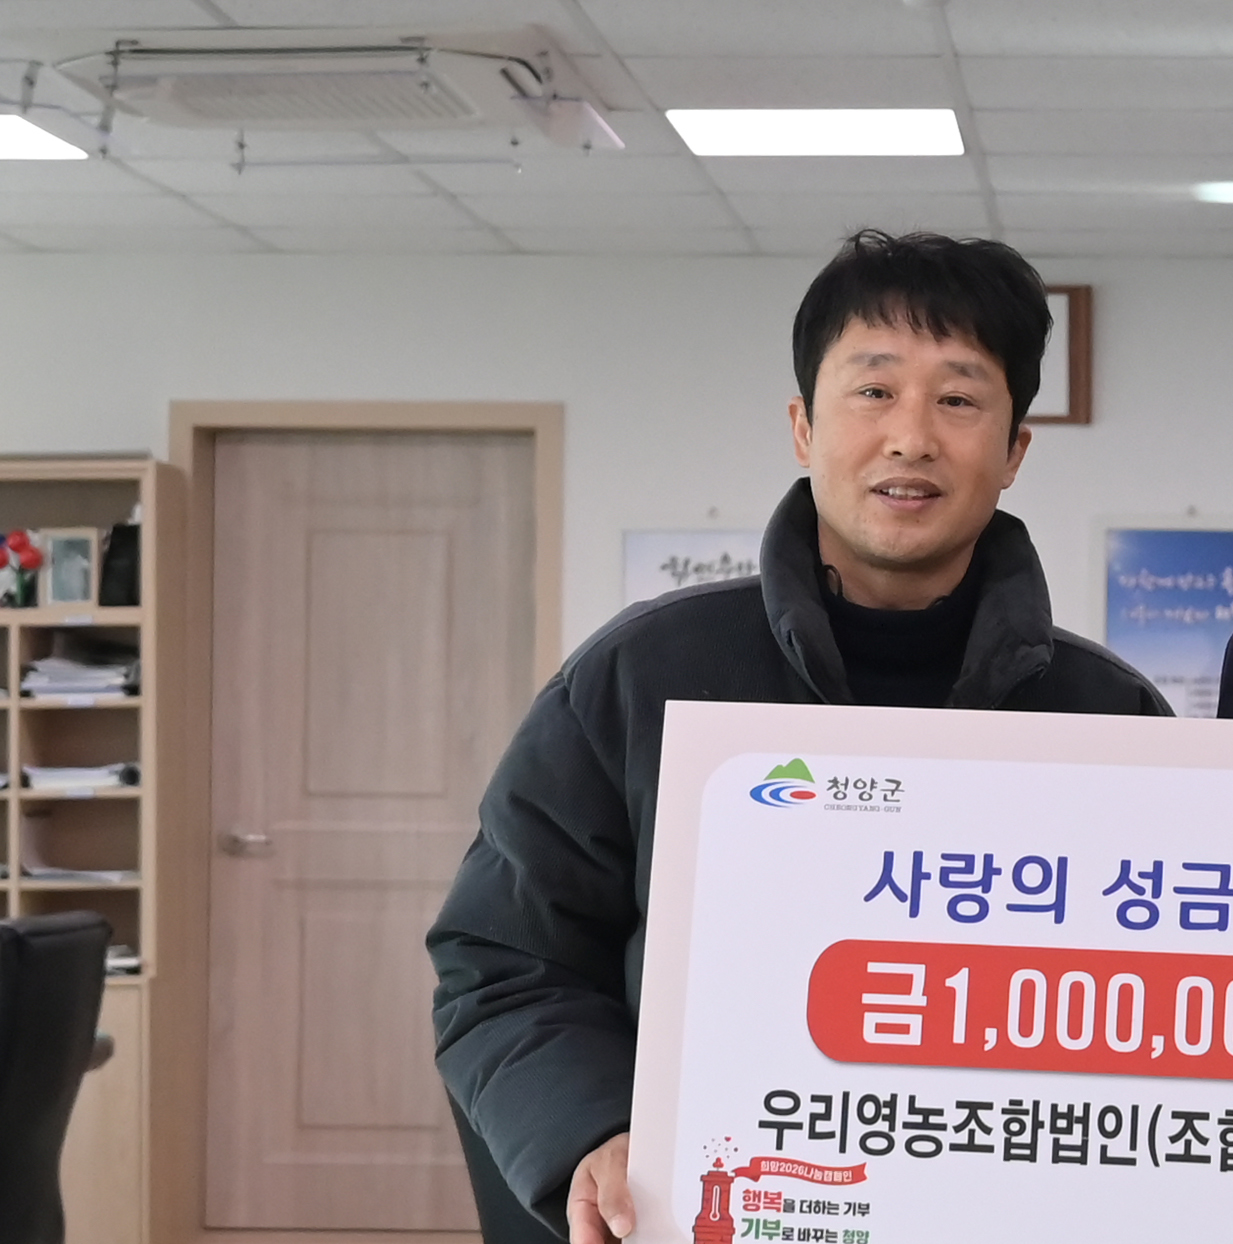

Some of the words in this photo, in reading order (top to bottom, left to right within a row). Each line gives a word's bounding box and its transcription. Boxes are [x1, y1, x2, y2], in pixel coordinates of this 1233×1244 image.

[826, 776, 905, 803] 청양군
[863, 850, 1069, 925] 사랑의
[760, 1160, 853, 1183] 희망2026나눔캠페인
[742, 1188, 796, 1214] 행복을
[799, 1199, 840, 1216] 더하는
[843, 1201, 871, 1217] 기부
[740, 1217, 795, 1241] 기부로
[797, 1227, 838, 1244] 바꾸는
[842, 1229, 870, 1244] 청양
